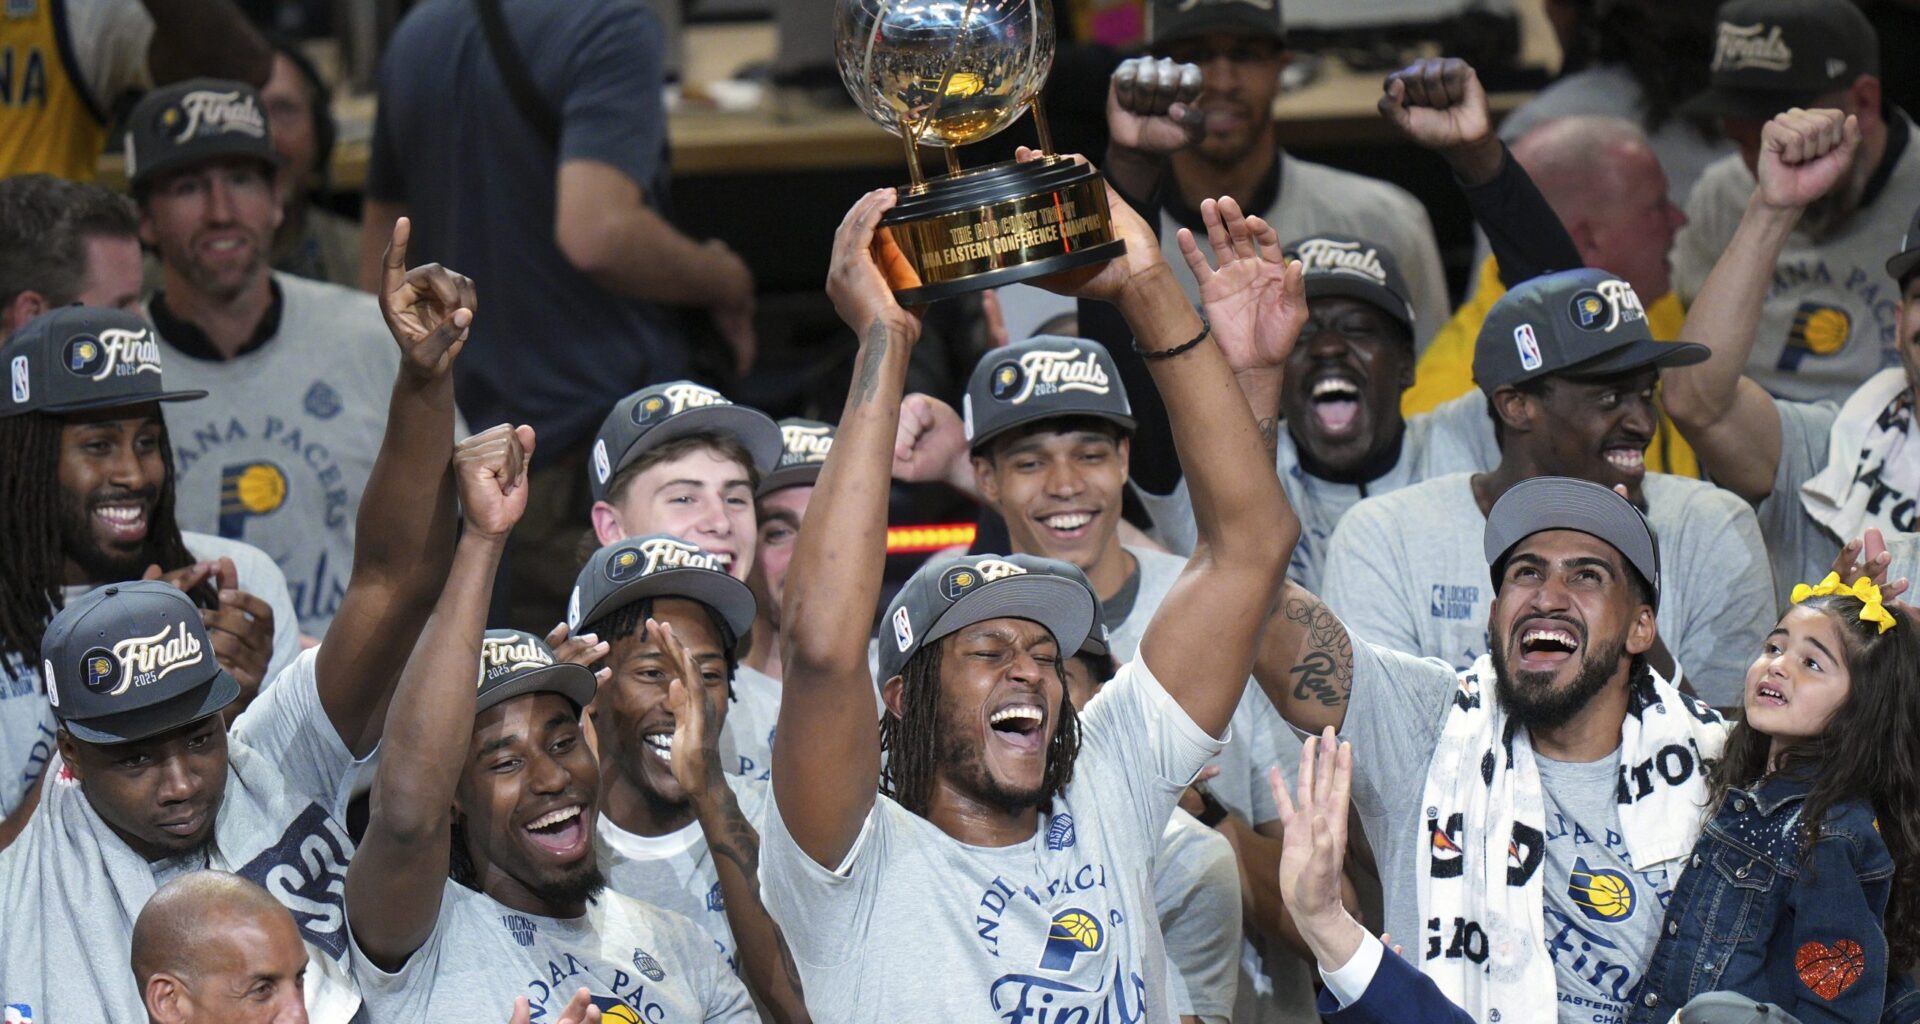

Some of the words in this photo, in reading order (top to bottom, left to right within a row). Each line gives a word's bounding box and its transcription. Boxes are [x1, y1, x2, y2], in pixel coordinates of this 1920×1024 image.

[175, 89, 265, 145] Finals
[943, 240, 992, 266] EASTERN
[993, 225, 1059, 255] CONFERENCE
[1297, 238, 1387, 286] Finals
[1011, 348, 1110, 405] Finals
[1034, 383, 1058, 397] 2025
[780, 425, 834, 454] Fina
[640, 538, 719, 577] Final
[110, 621, 204, 696] Finals
[486, 664, 511, 681] 2025
[133, 671, 158, 688] 2025
[1556, 991, 1625, 1014] EASTERN
